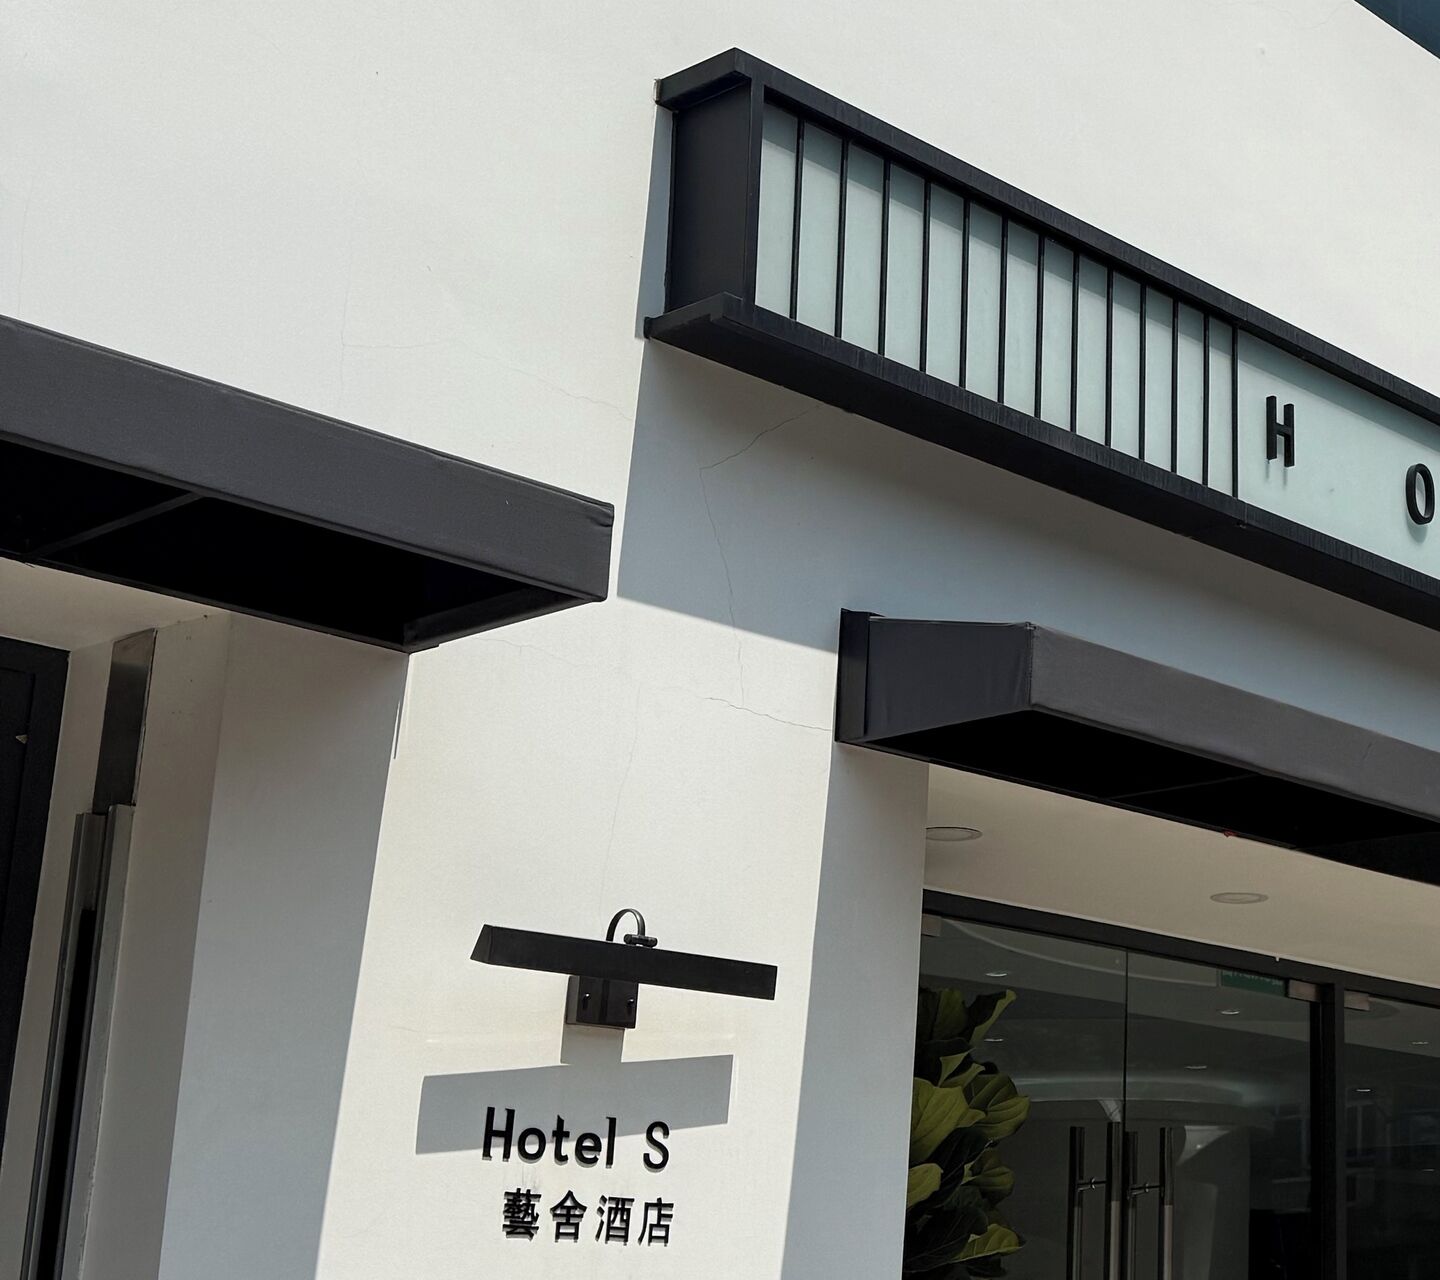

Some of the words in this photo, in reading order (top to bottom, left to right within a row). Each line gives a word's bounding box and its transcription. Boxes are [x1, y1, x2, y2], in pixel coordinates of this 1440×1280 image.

[482, 1107, 617, 1169] Hotel
[643, 1121, 670, 1173] S
[502, 1187, 674, 1247] 藝舍酒店
